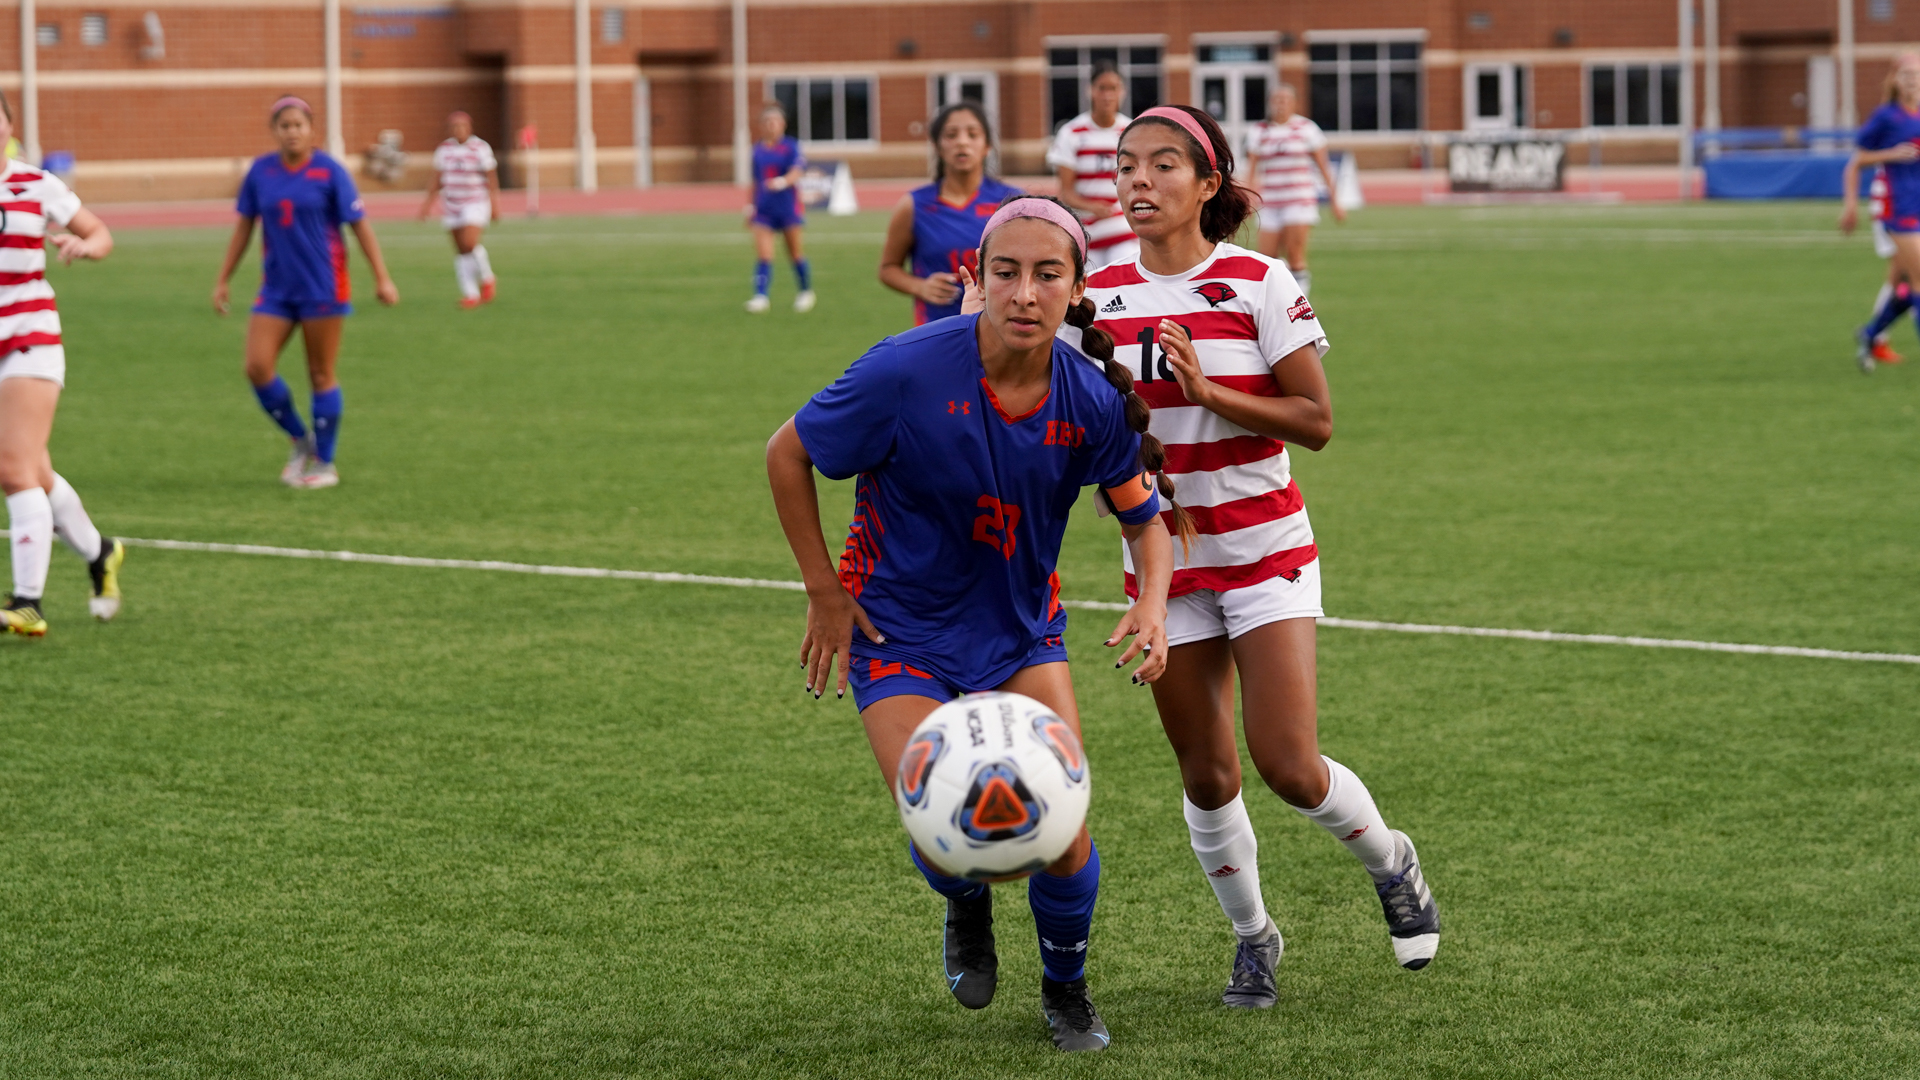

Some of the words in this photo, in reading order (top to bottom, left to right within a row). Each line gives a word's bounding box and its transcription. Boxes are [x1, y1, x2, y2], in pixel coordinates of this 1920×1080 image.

[1450, 143, 1563, 181] READY
[1043, 420, 1085, 448] HBU
[972, 494, 1022, 561] 23
[967, 708, 985, 747] NCAA
